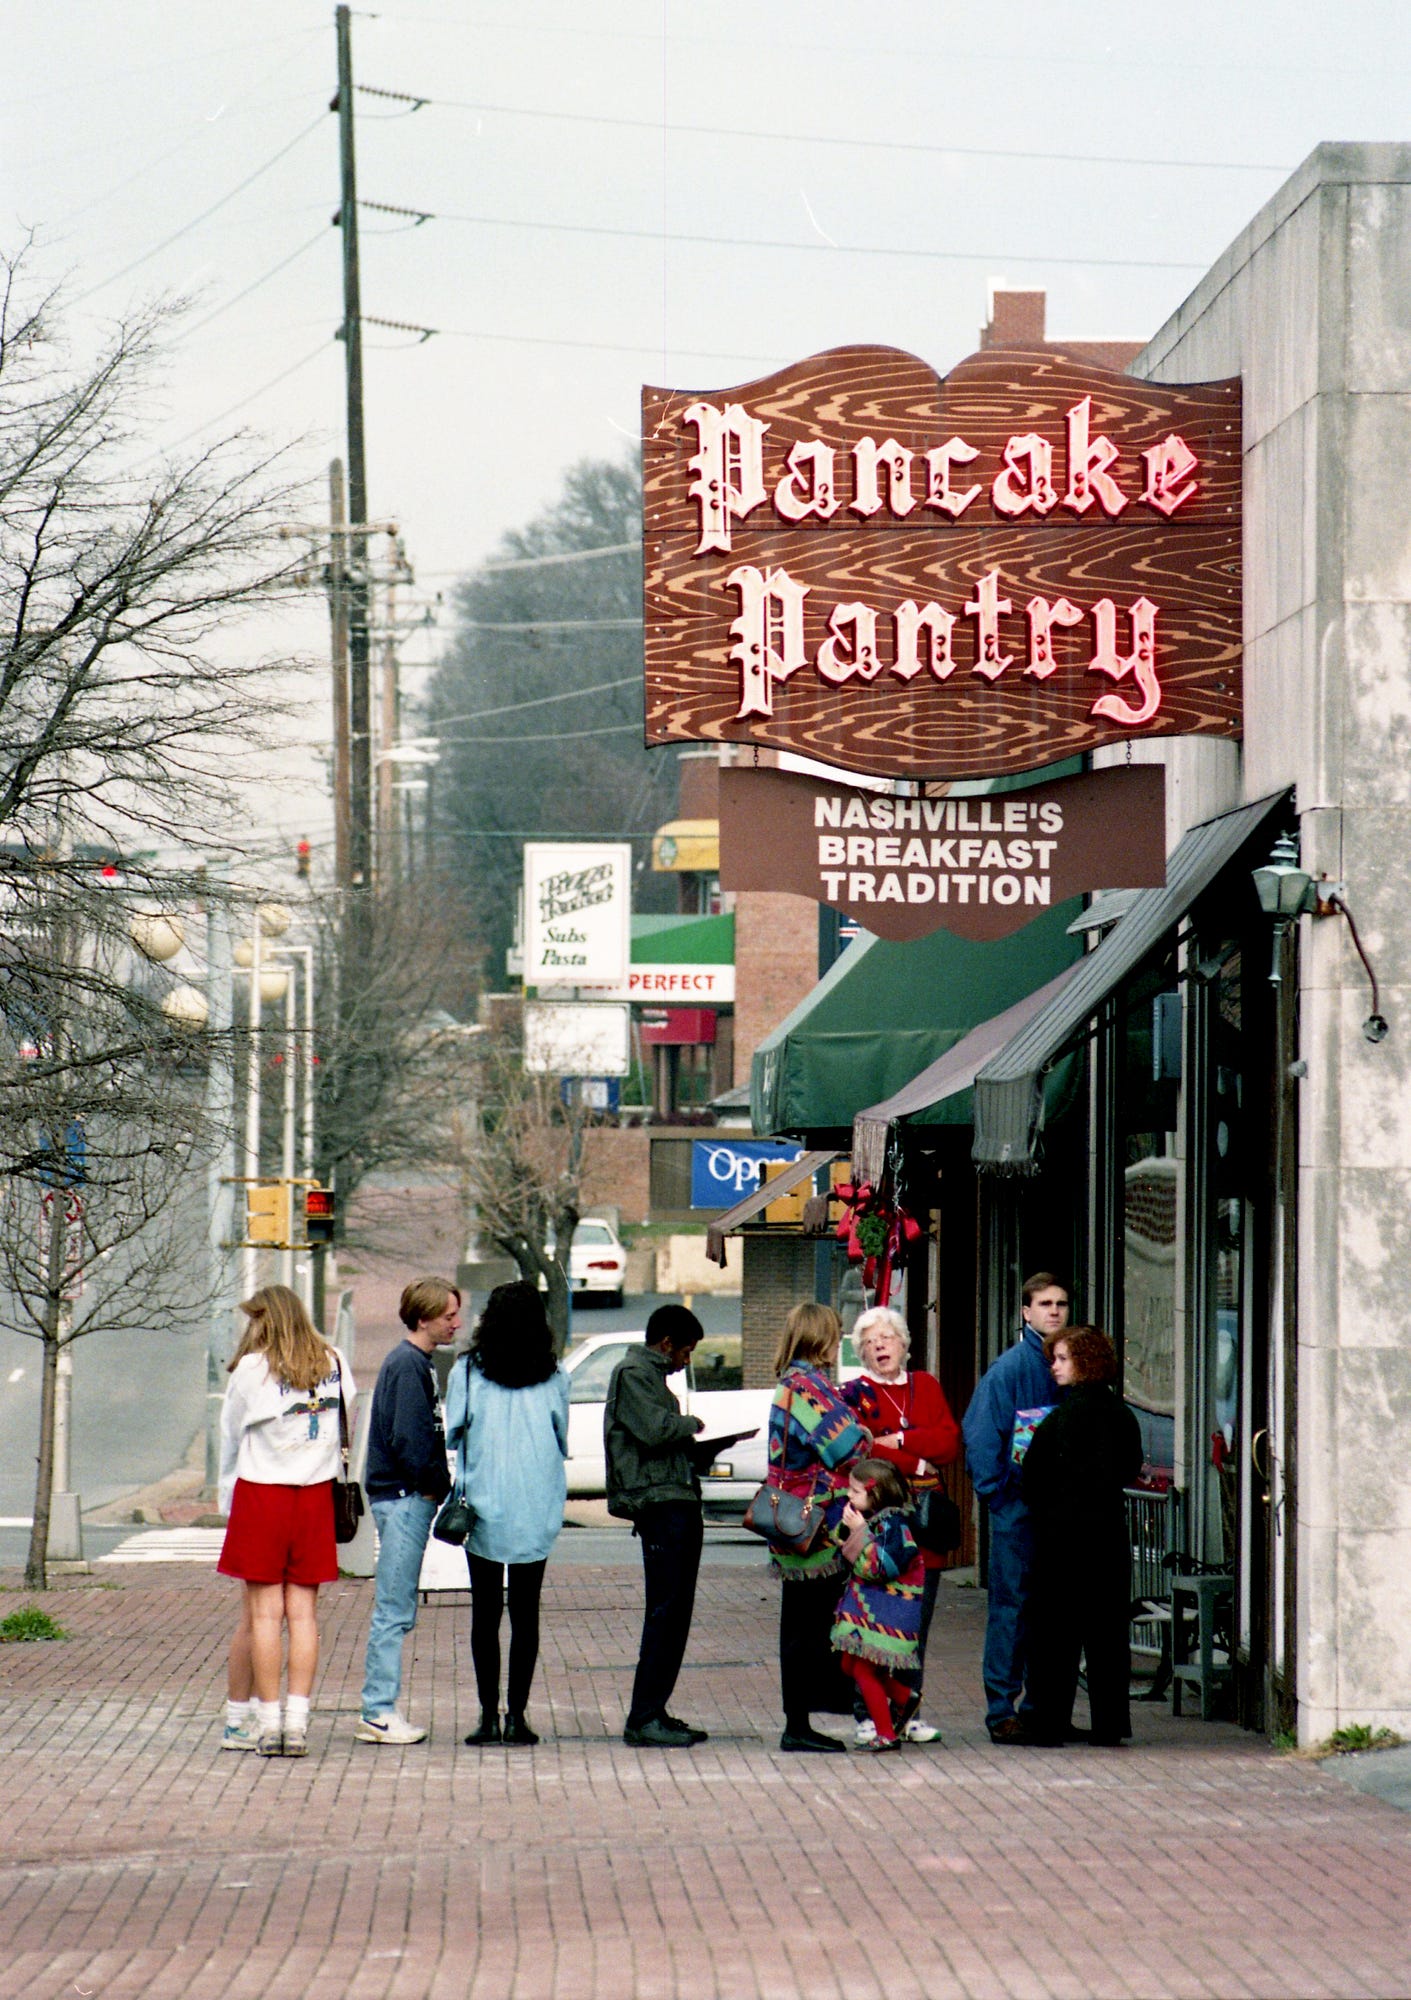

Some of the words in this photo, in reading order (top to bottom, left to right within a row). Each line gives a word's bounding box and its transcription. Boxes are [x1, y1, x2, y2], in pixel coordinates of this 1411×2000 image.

[683, 395, 1199, 557] Pancake
[725, 565, 1162, 724] Pantry
[813, 796, 1064, 834] NASHVILLE'S
[818, 836, 1058, 869] BREAKFAST
[820, 871, 1051, 905] TRADITION
[543, 926, 586, 943] Subs
[541, 948, 587, 966] Pasta
[629, 974, 714, 990] PERFECT
